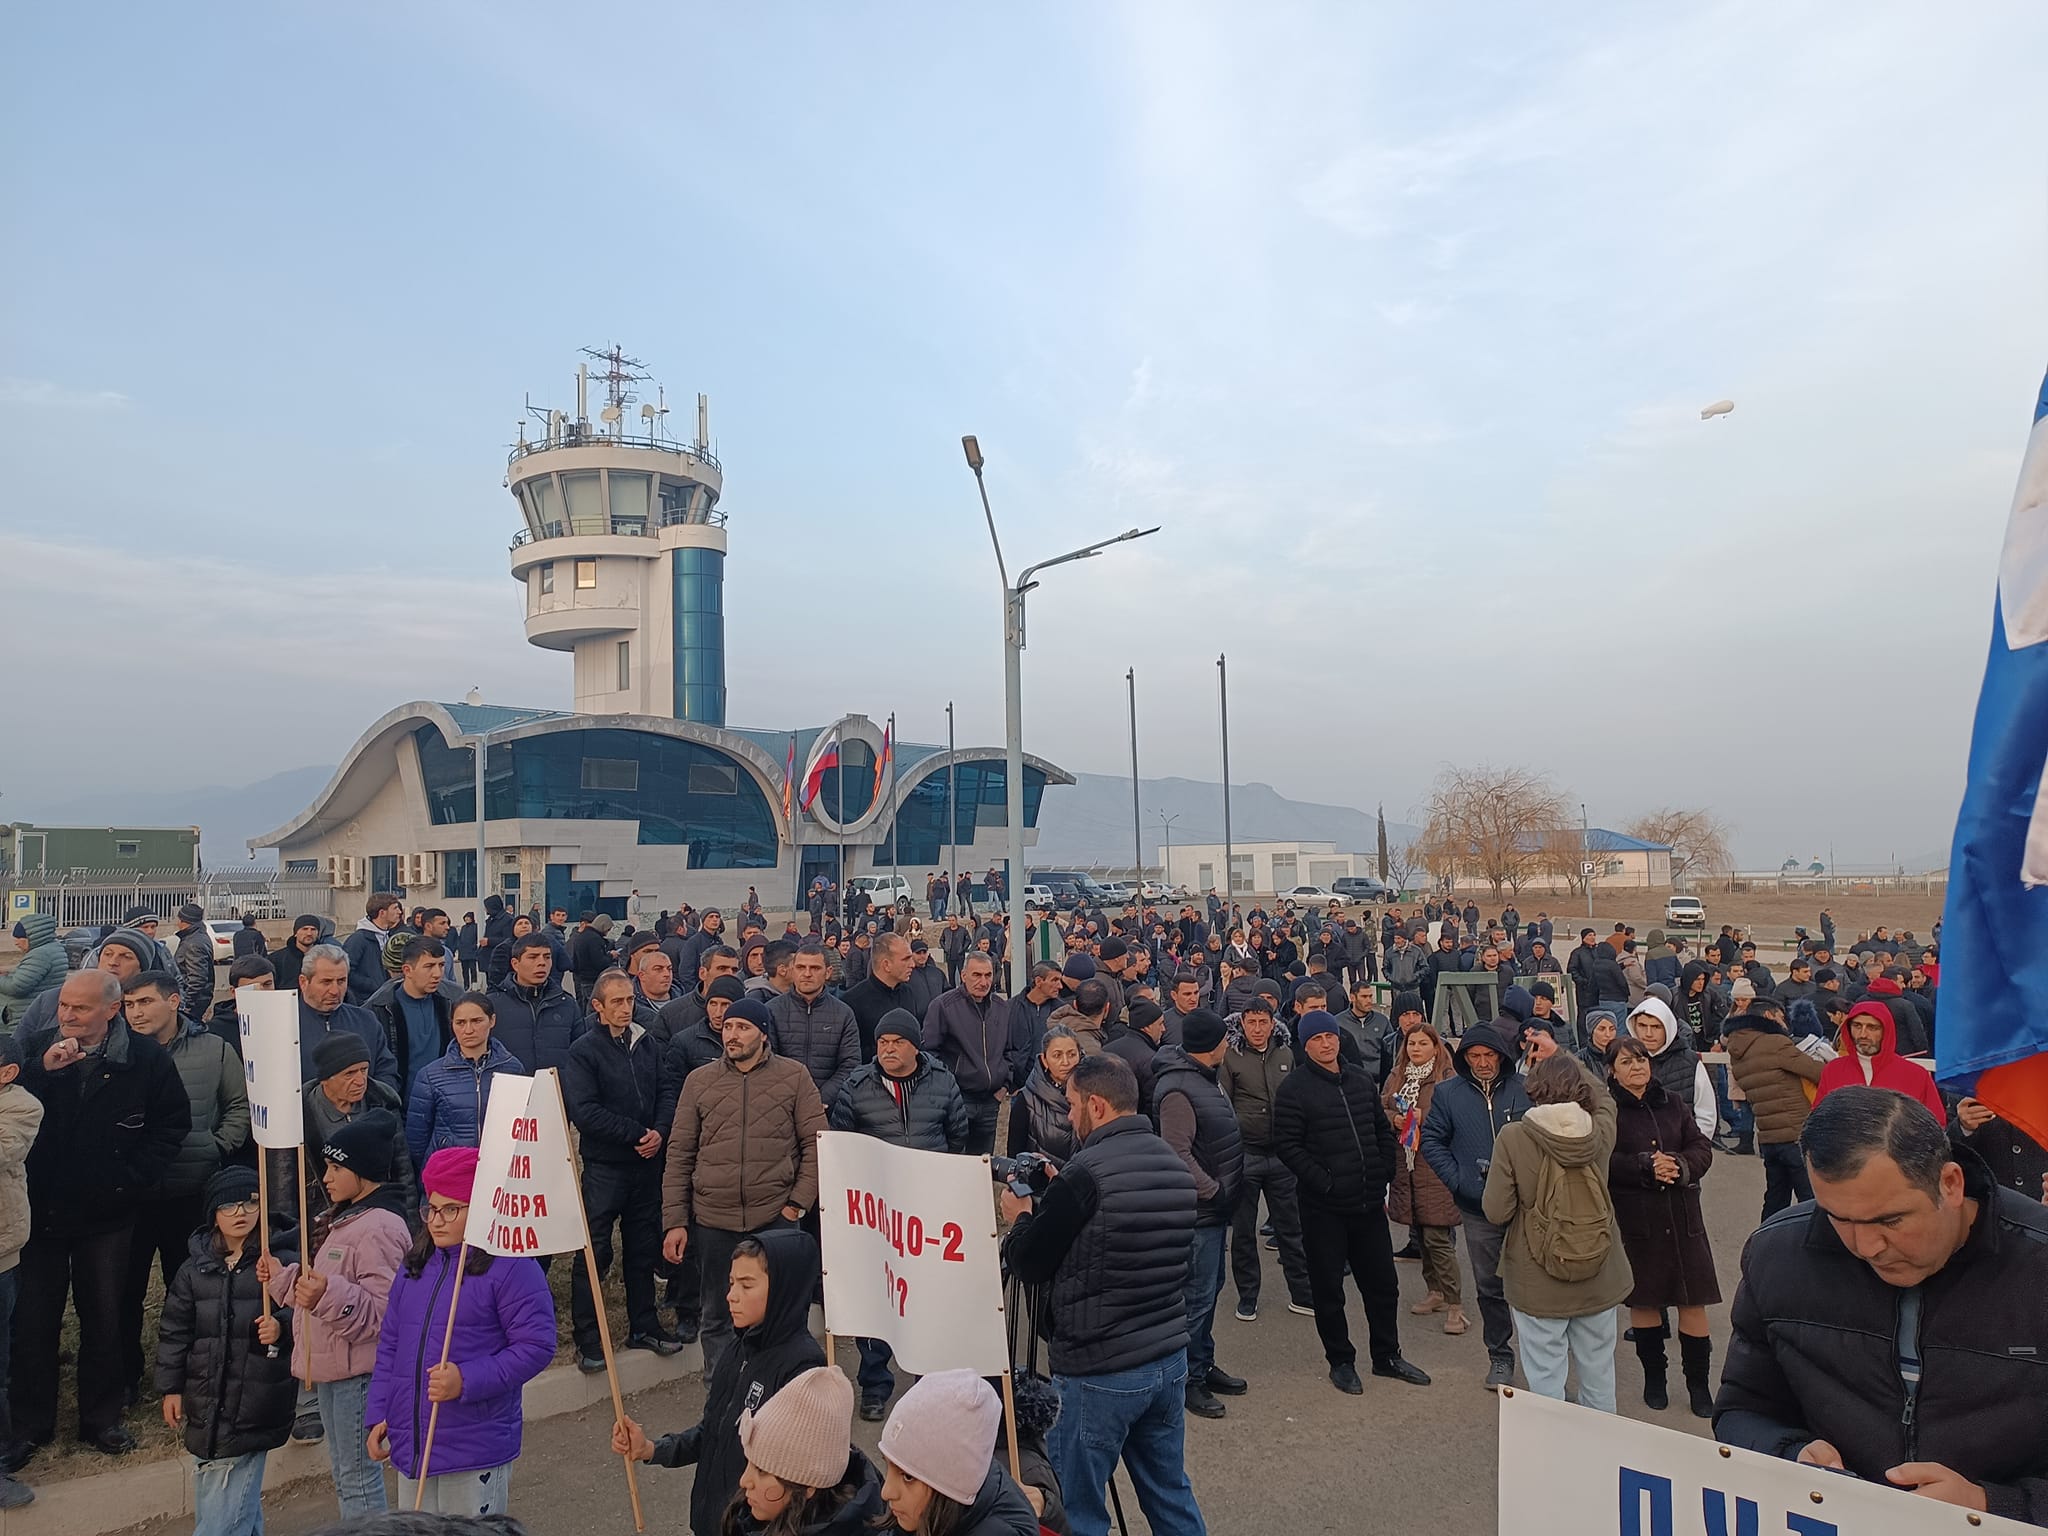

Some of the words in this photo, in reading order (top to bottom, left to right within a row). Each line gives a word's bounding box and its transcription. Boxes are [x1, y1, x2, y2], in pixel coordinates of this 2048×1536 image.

[1584, 863, 1593, 873] P
[16, 895, 28, 907] P
[846, 1188, 965, 1262] КОЛЬЦО-2
[497, 1225, 539, 1253] ГОДА
